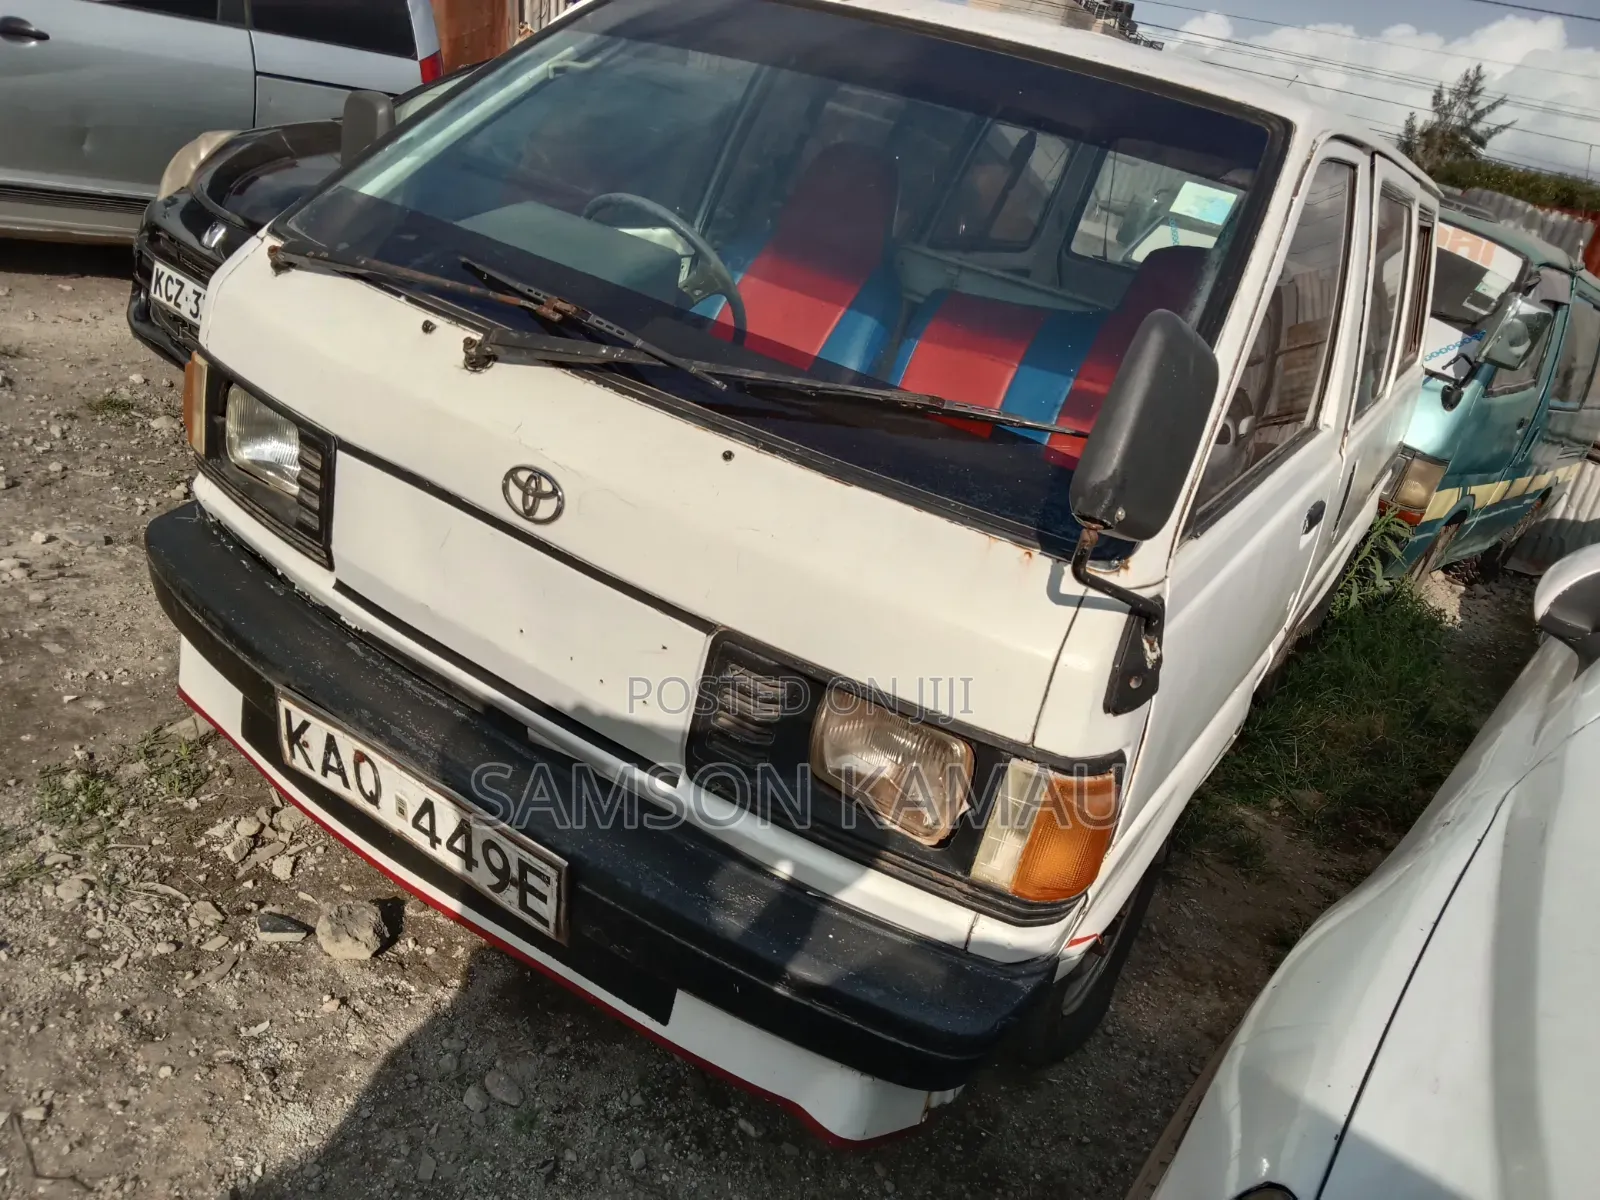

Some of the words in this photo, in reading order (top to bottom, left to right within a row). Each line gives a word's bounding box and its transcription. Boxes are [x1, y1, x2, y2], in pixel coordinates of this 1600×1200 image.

[153, 267, 185, 309] KCZ
[189, 289, 206, 321] 3
[285, 708, 383, 810] KAQ
[411, 797, 551, 929] 449E
